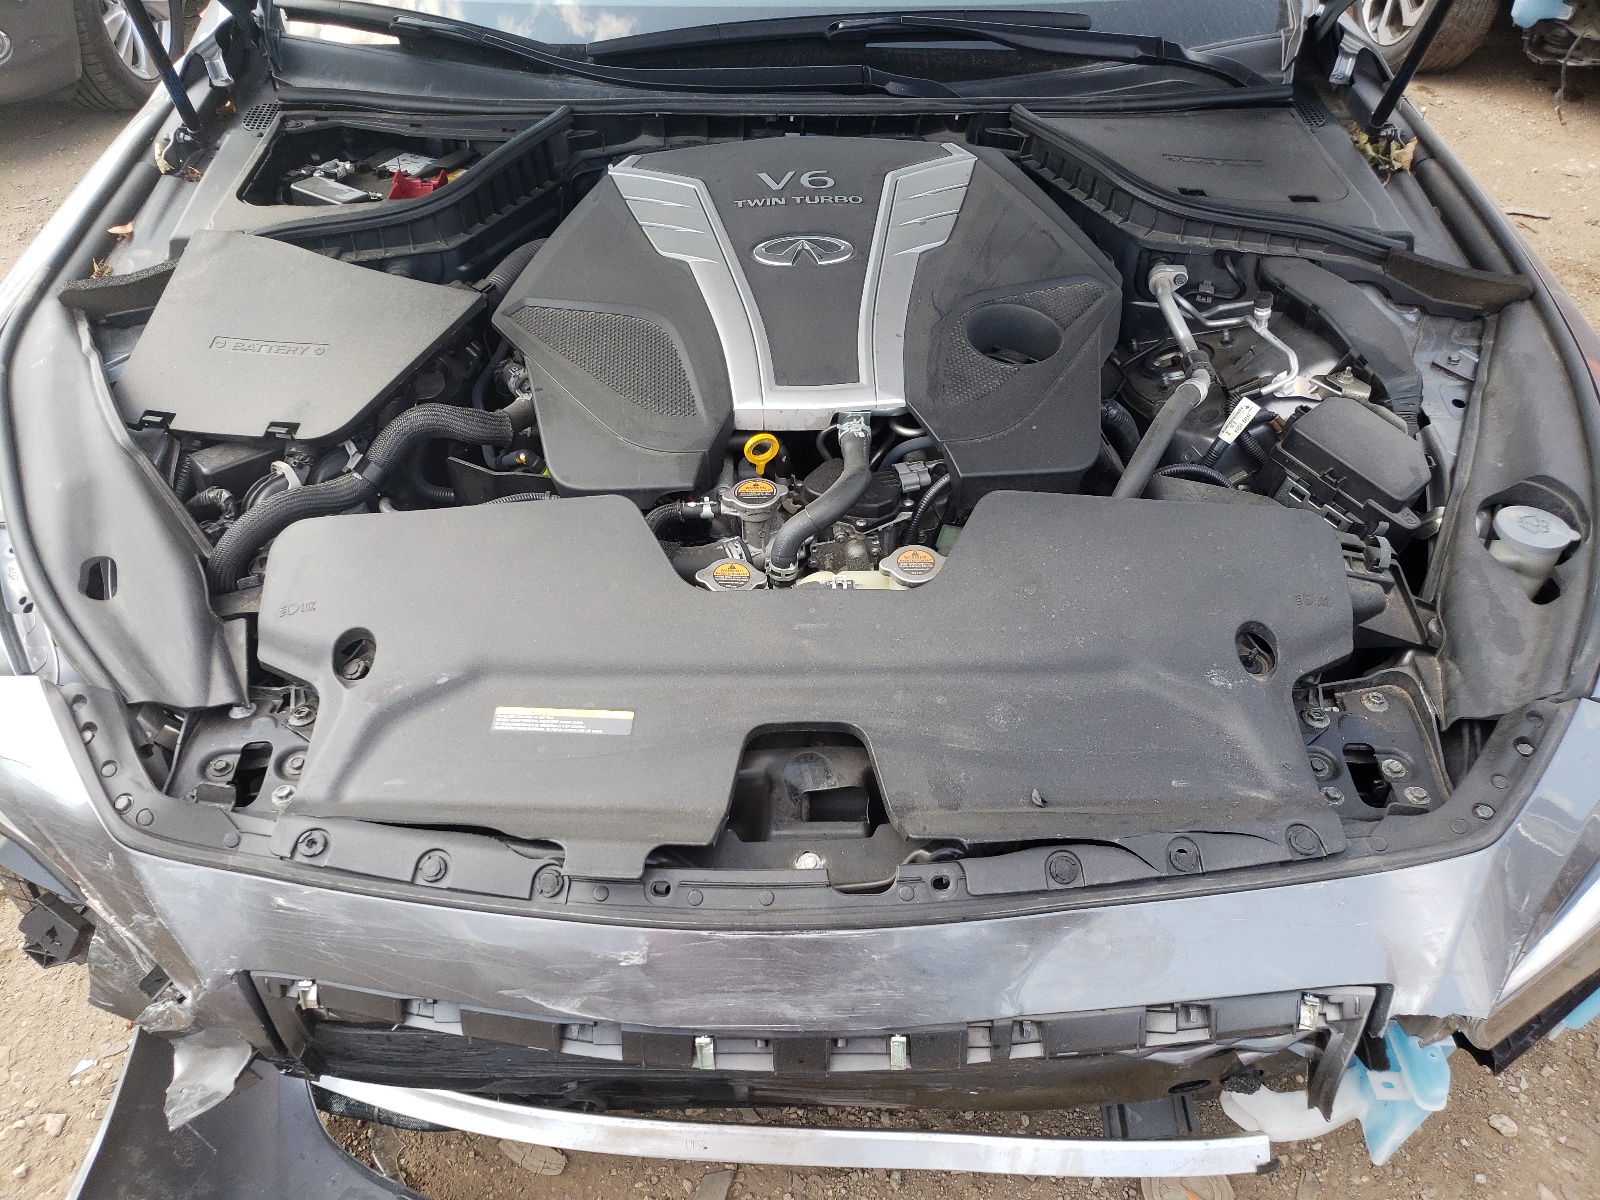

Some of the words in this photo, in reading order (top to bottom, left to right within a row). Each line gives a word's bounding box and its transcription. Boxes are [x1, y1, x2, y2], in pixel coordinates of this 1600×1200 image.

[757, 170, 835, 191] V6
[734, 197, 786, 208] TWIN
[792, 195, 863, 204] TURBO
[232, 342, 310, 355] BATTERY
